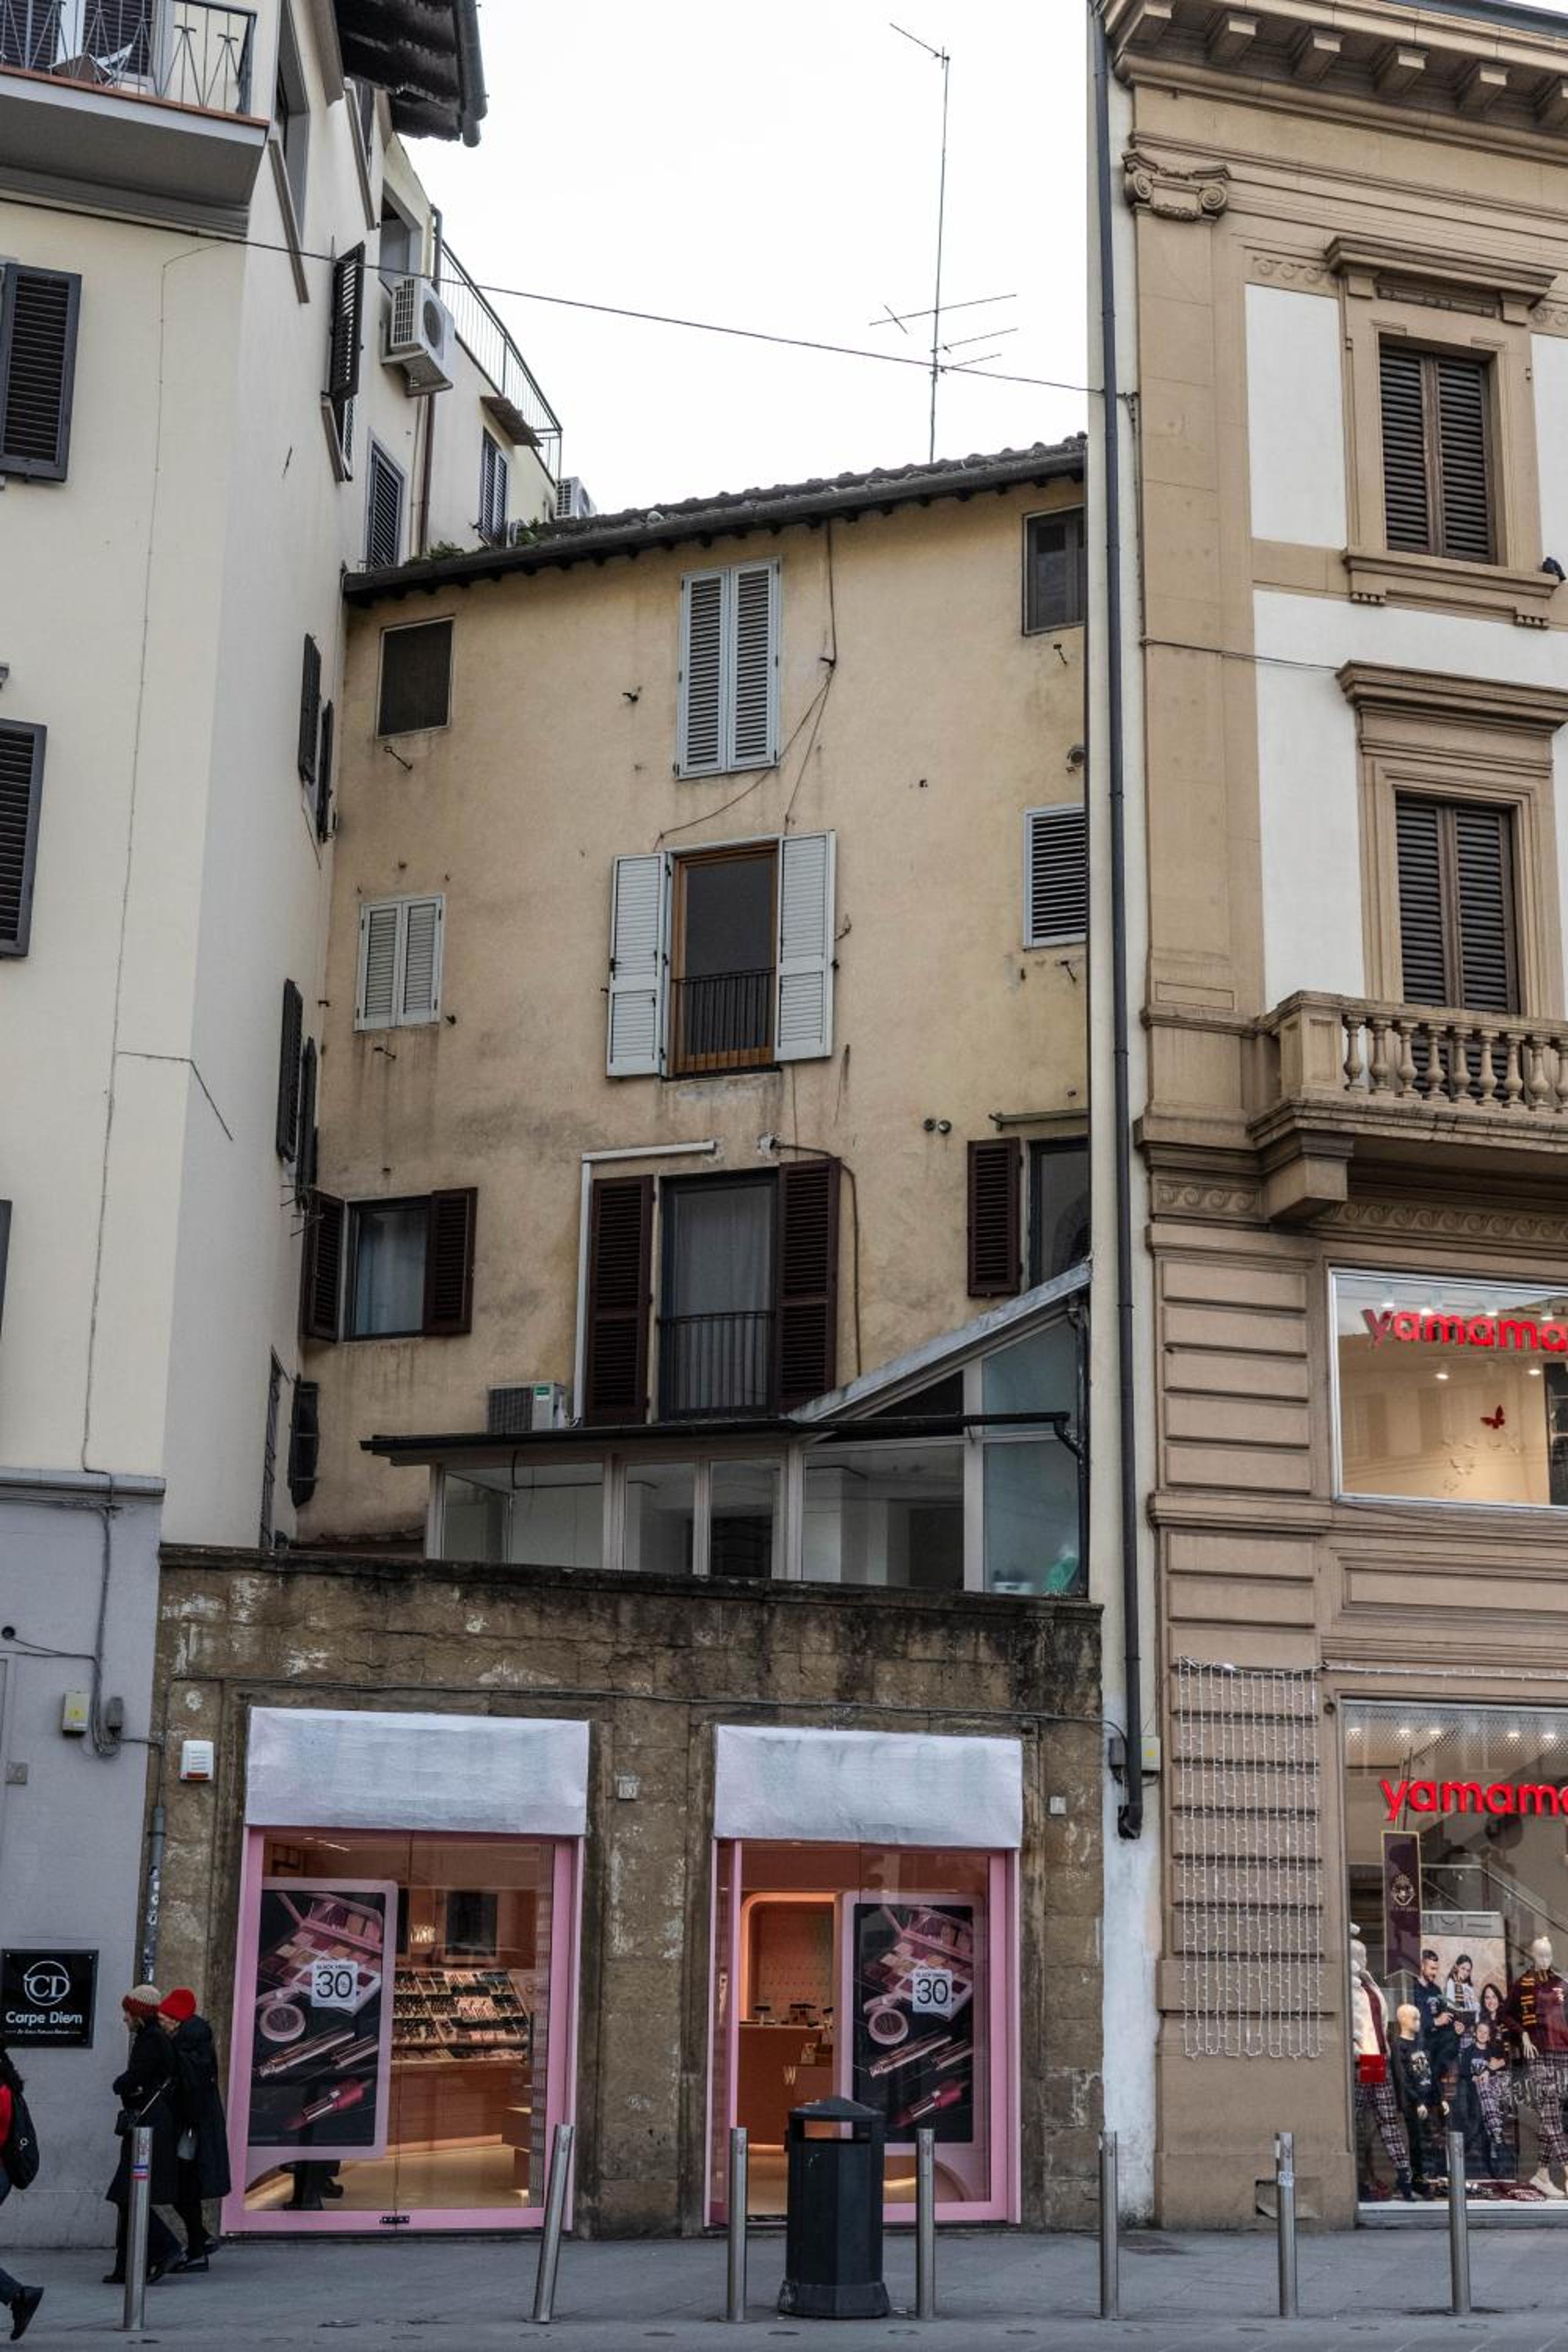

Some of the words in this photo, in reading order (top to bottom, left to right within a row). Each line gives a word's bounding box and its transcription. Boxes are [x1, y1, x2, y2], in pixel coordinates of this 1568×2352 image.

[1381, 1780, 1568, 1821] yamam
[5, 2011, 45, 2027] Carpe
[49, 2011, 82, 2024] Diem
